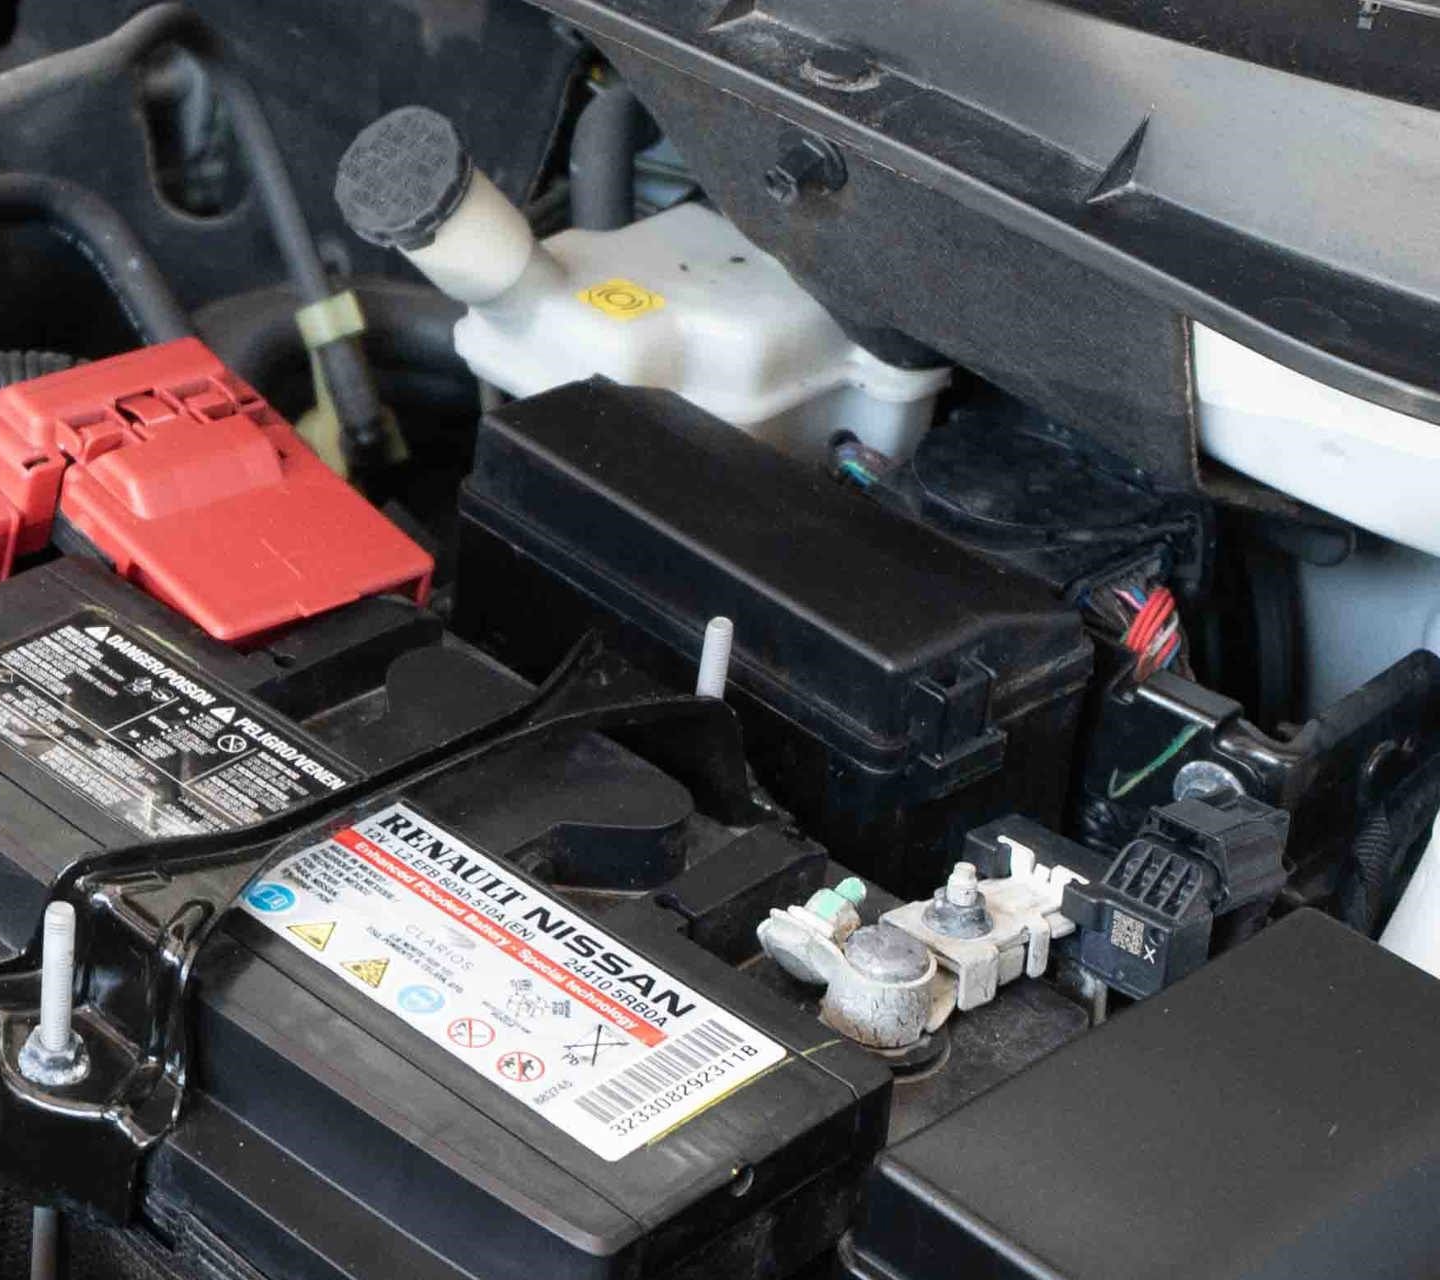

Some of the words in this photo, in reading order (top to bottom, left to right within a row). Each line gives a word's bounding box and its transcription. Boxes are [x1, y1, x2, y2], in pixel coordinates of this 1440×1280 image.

[105, 633, 216, 707] DANGER/POISON
[361, 826, 391, 845] 12V
[392, 847, 417, 863] L2
[409, 858, 442, 879] EFB
[436, 875, 476, 901] 60Ah
[470, 897, 509, 923] 510A
[501, 918, 538, 942] (EN)
[378, 814, 527, 907] RENAULT
[524, 907, 697, 1018] NISSAN
[351, 840, 419, 884] Enhanced
[411, 879, 469, 917] Flooded
[459, 912, 514, 948] Battery
[514, 948, 570, 984] Special
[561, 979, 641, 1031] technology
[401, 922, 477, 972] CLARIOS
[561, 956, 614, 991] 24410
